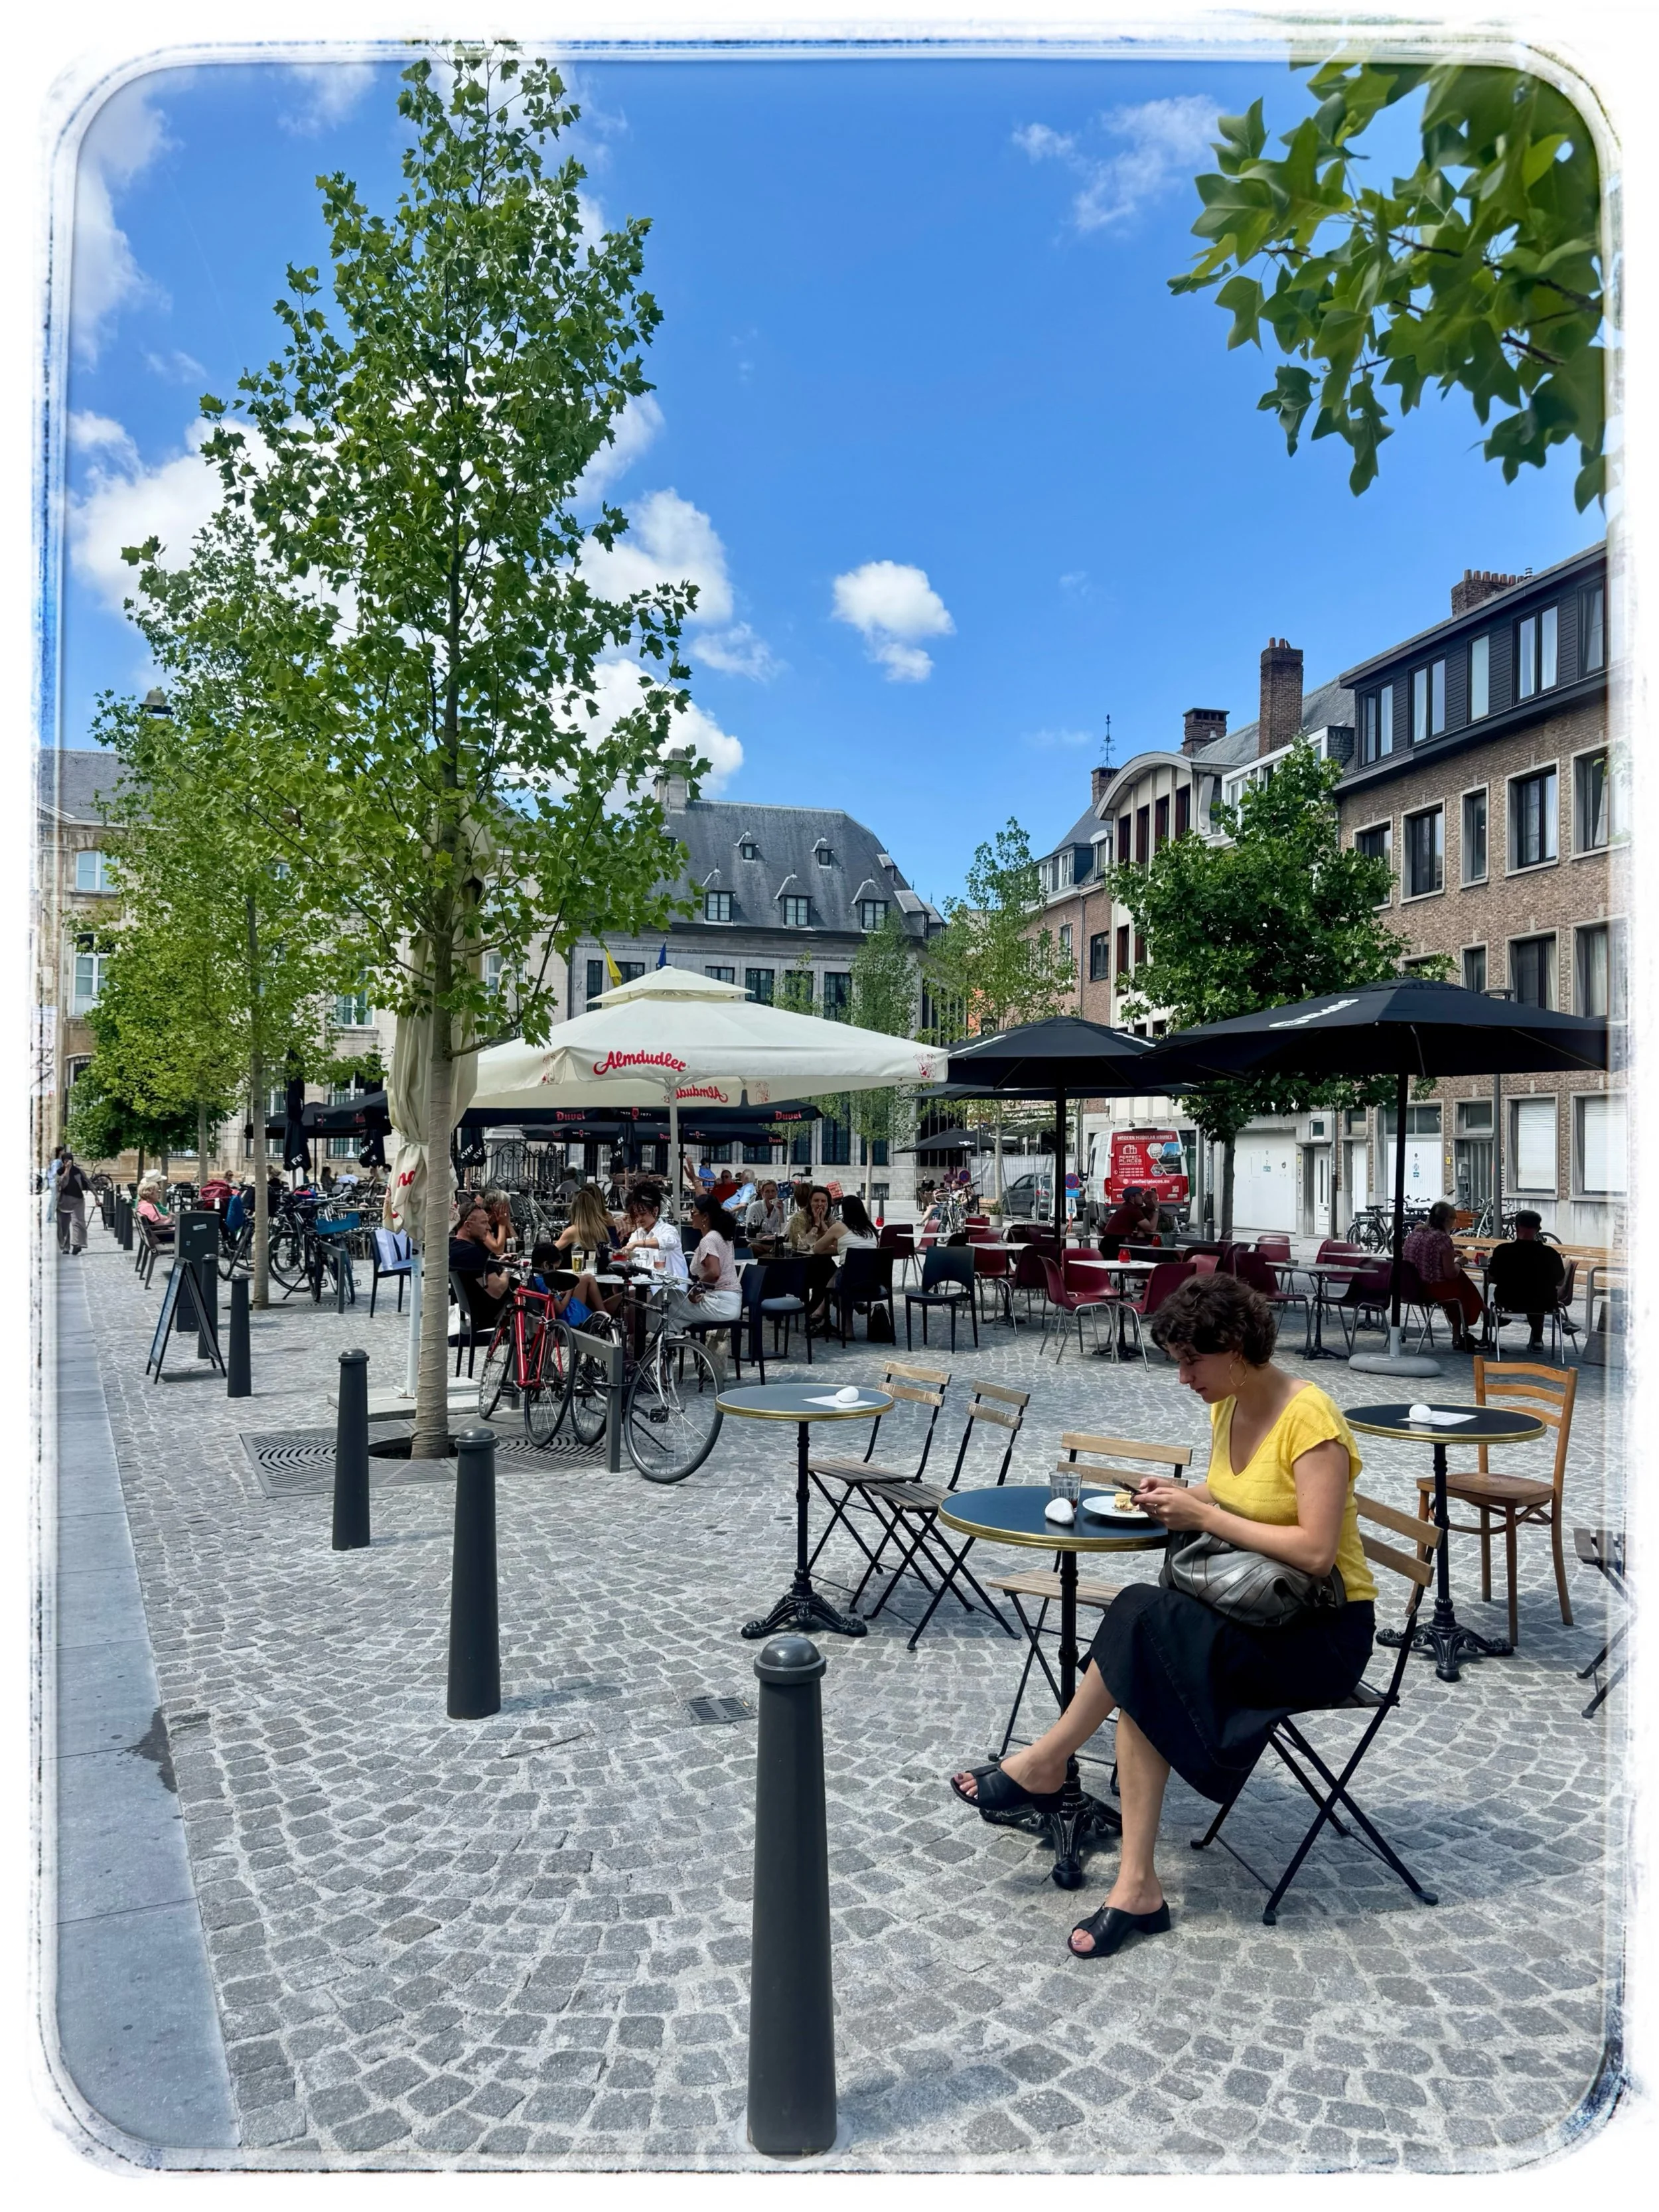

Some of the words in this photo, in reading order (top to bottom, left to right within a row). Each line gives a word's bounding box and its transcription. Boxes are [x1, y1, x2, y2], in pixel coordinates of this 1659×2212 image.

[593, 1050, 687, 1074] Almdudler
[555, 1110, 585, 1120] Duvel
[775, 1110, 802, 1120] Duvel
